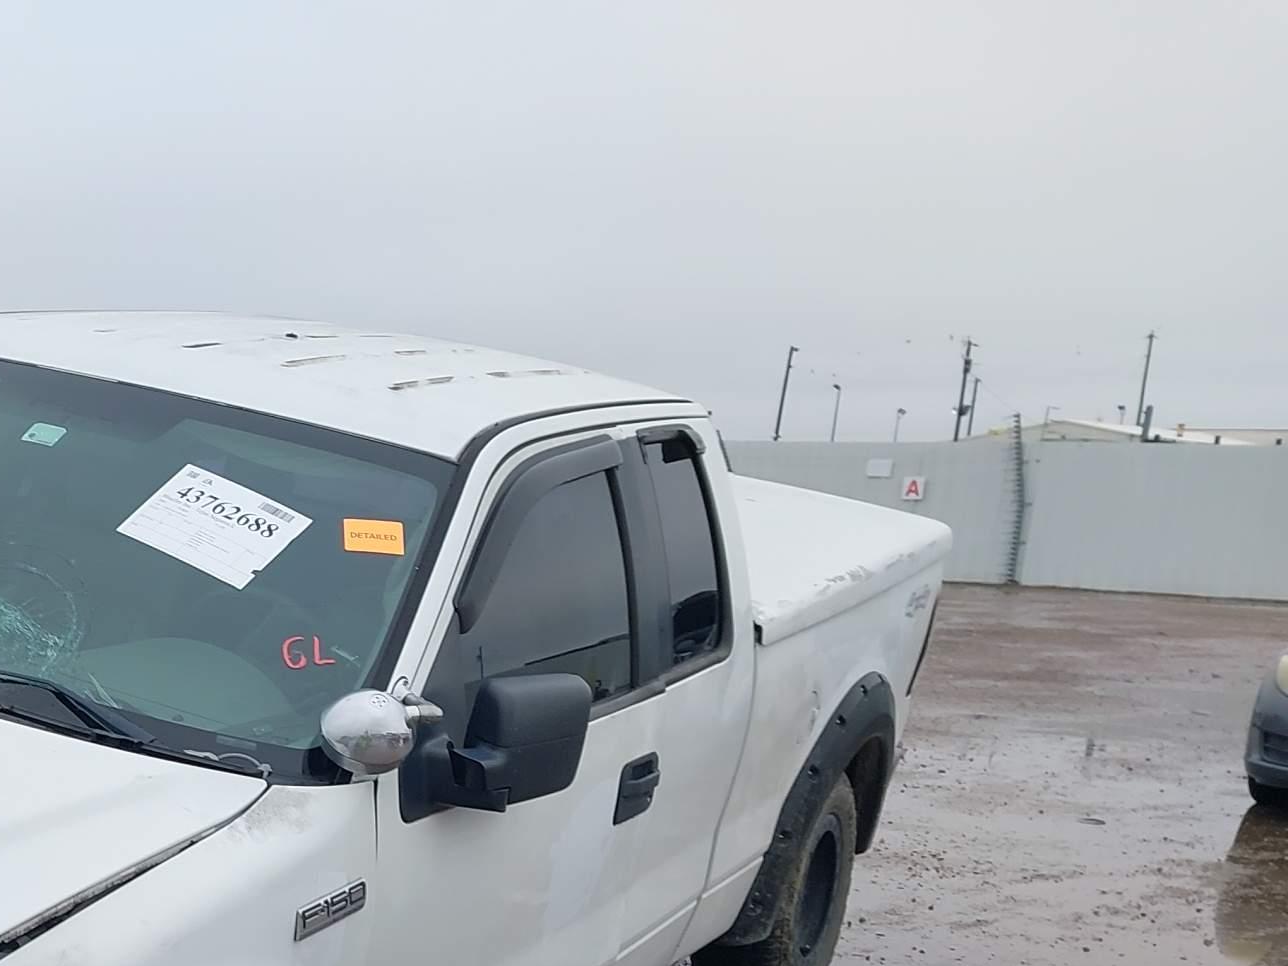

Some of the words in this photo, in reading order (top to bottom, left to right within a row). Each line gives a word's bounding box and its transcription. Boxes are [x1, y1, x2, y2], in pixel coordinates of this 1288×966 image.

[905, 479, 920, 497] A
[176, 486, 280, 538] 43762688
[349, 531, 398, 542] DETAILED
